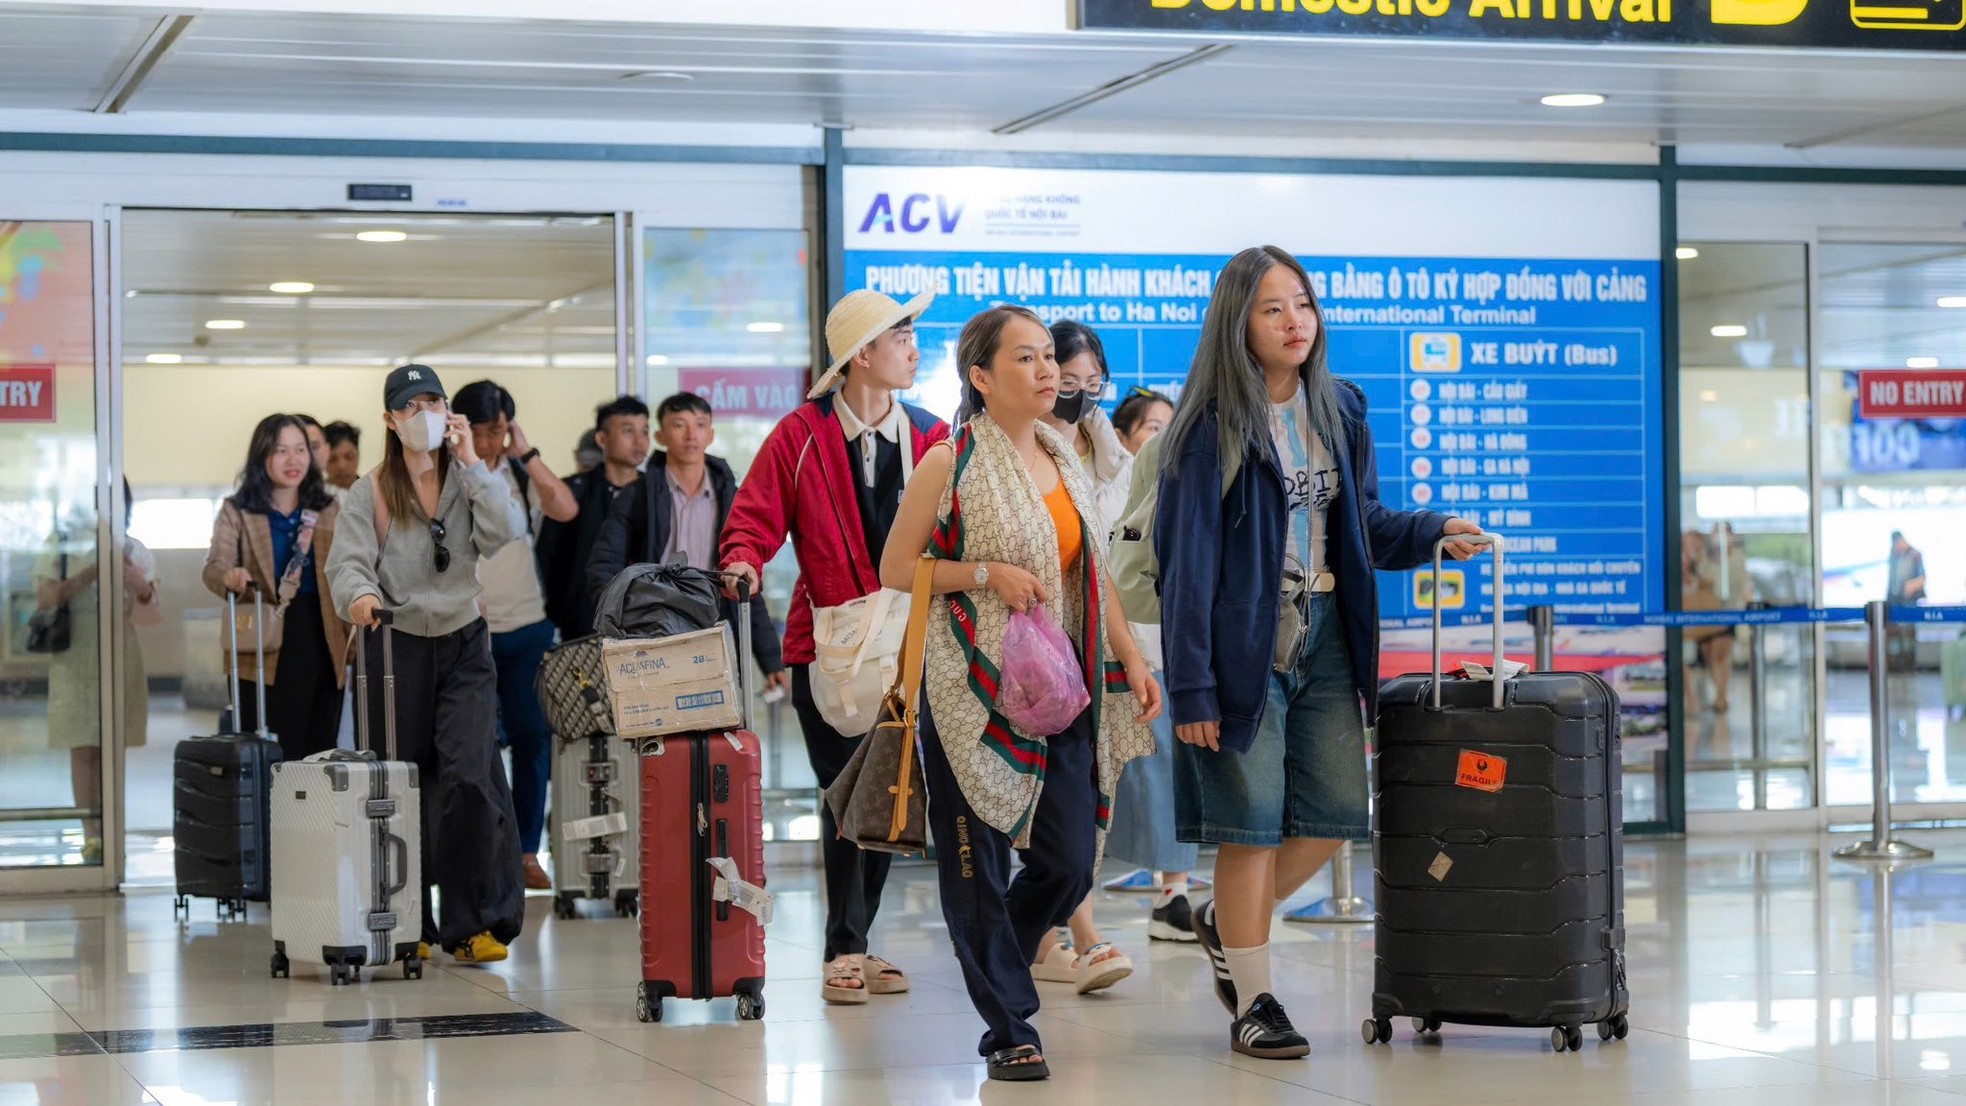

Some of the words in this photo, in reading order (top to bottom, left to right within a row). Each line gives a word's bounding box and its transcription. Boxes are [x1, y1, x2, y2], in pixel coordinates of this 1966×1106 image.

[859, 192, 966, 233] ACV
[1085, 263, 1140, 297] HÀNH
[1145, 264, 1211, 298] KHÁCH
[1099, 302, 1123, 322] to
[1127, 303, 1156, 322] Ha
[1161, 303, 1197, 322] Noi
[1323, 305, 1445, 325] nternational
[1449, 305, 1537, 325] Terminal
[1471, 343, 1499, 365] XE
[1564, 344, 1618, 367] (Bus)
[1870, 381, 1899, 406] NO
[1903, 381, 1965, 406] ENTRY
